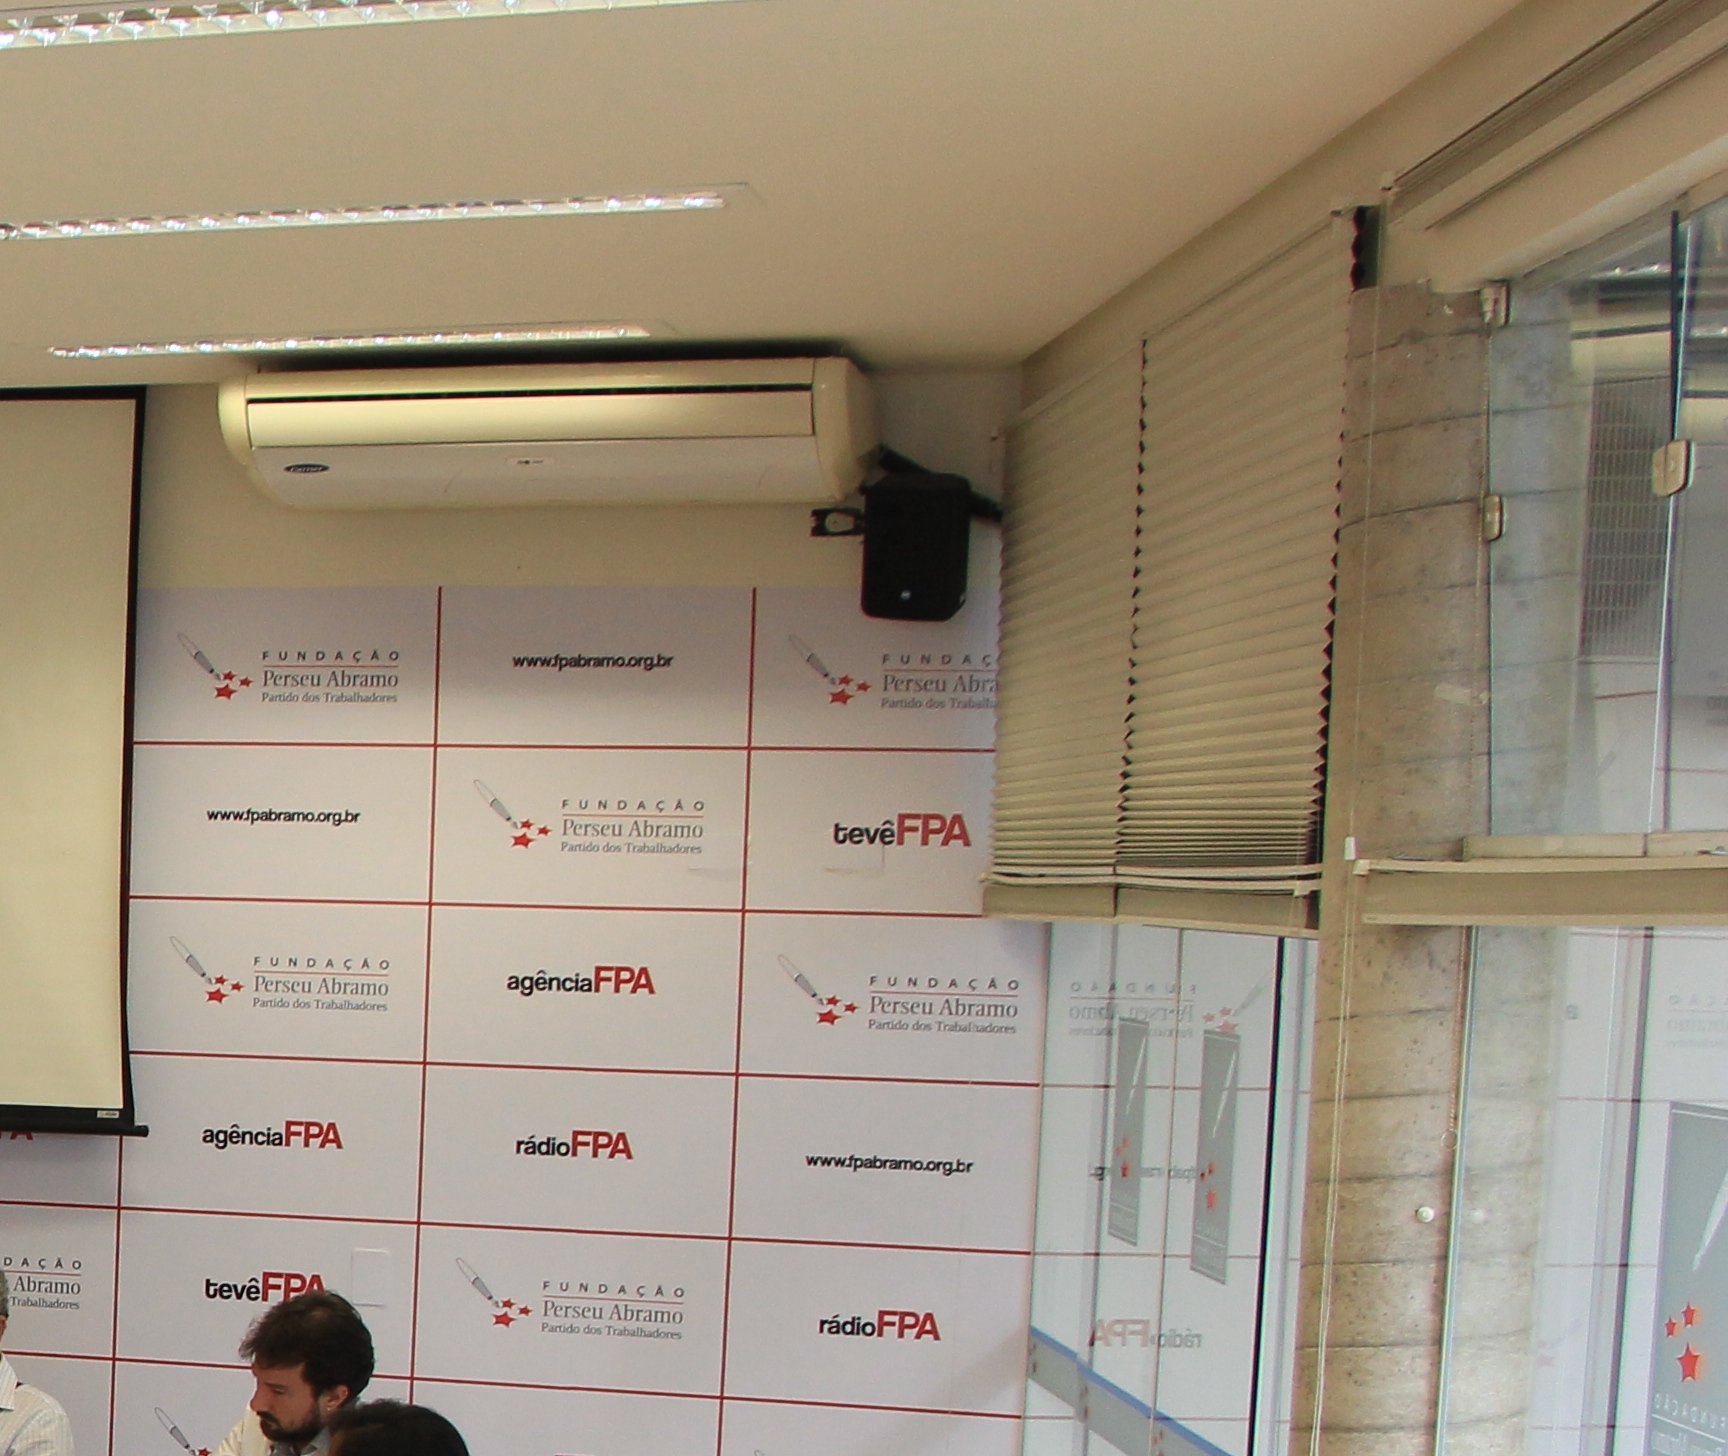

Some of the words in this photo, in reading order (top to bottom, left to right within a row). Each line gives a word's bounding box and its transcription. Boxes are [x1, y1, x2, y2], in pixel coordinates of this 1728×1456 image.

[262, 650, 399, 664] FUNDAÇÃO
[262, 669, 321, 688] Perseu
[326, 669, 398, 689] Abramo
[261, 692, 299, 703] Partido
[302, 692, 320, 703] dos
[324, 692, 398, 704] Trabalhadores
[206, 808, 360, 826] www.fpabramo.org.br
[833, 812, 972, 847] tevêFPA
[506, 966, 656, 997] agênciaFPA
[515, 1130, 633, 1160] rádioFPA
[805, 1152, 973, 1177] www.fpabramo.org.br
